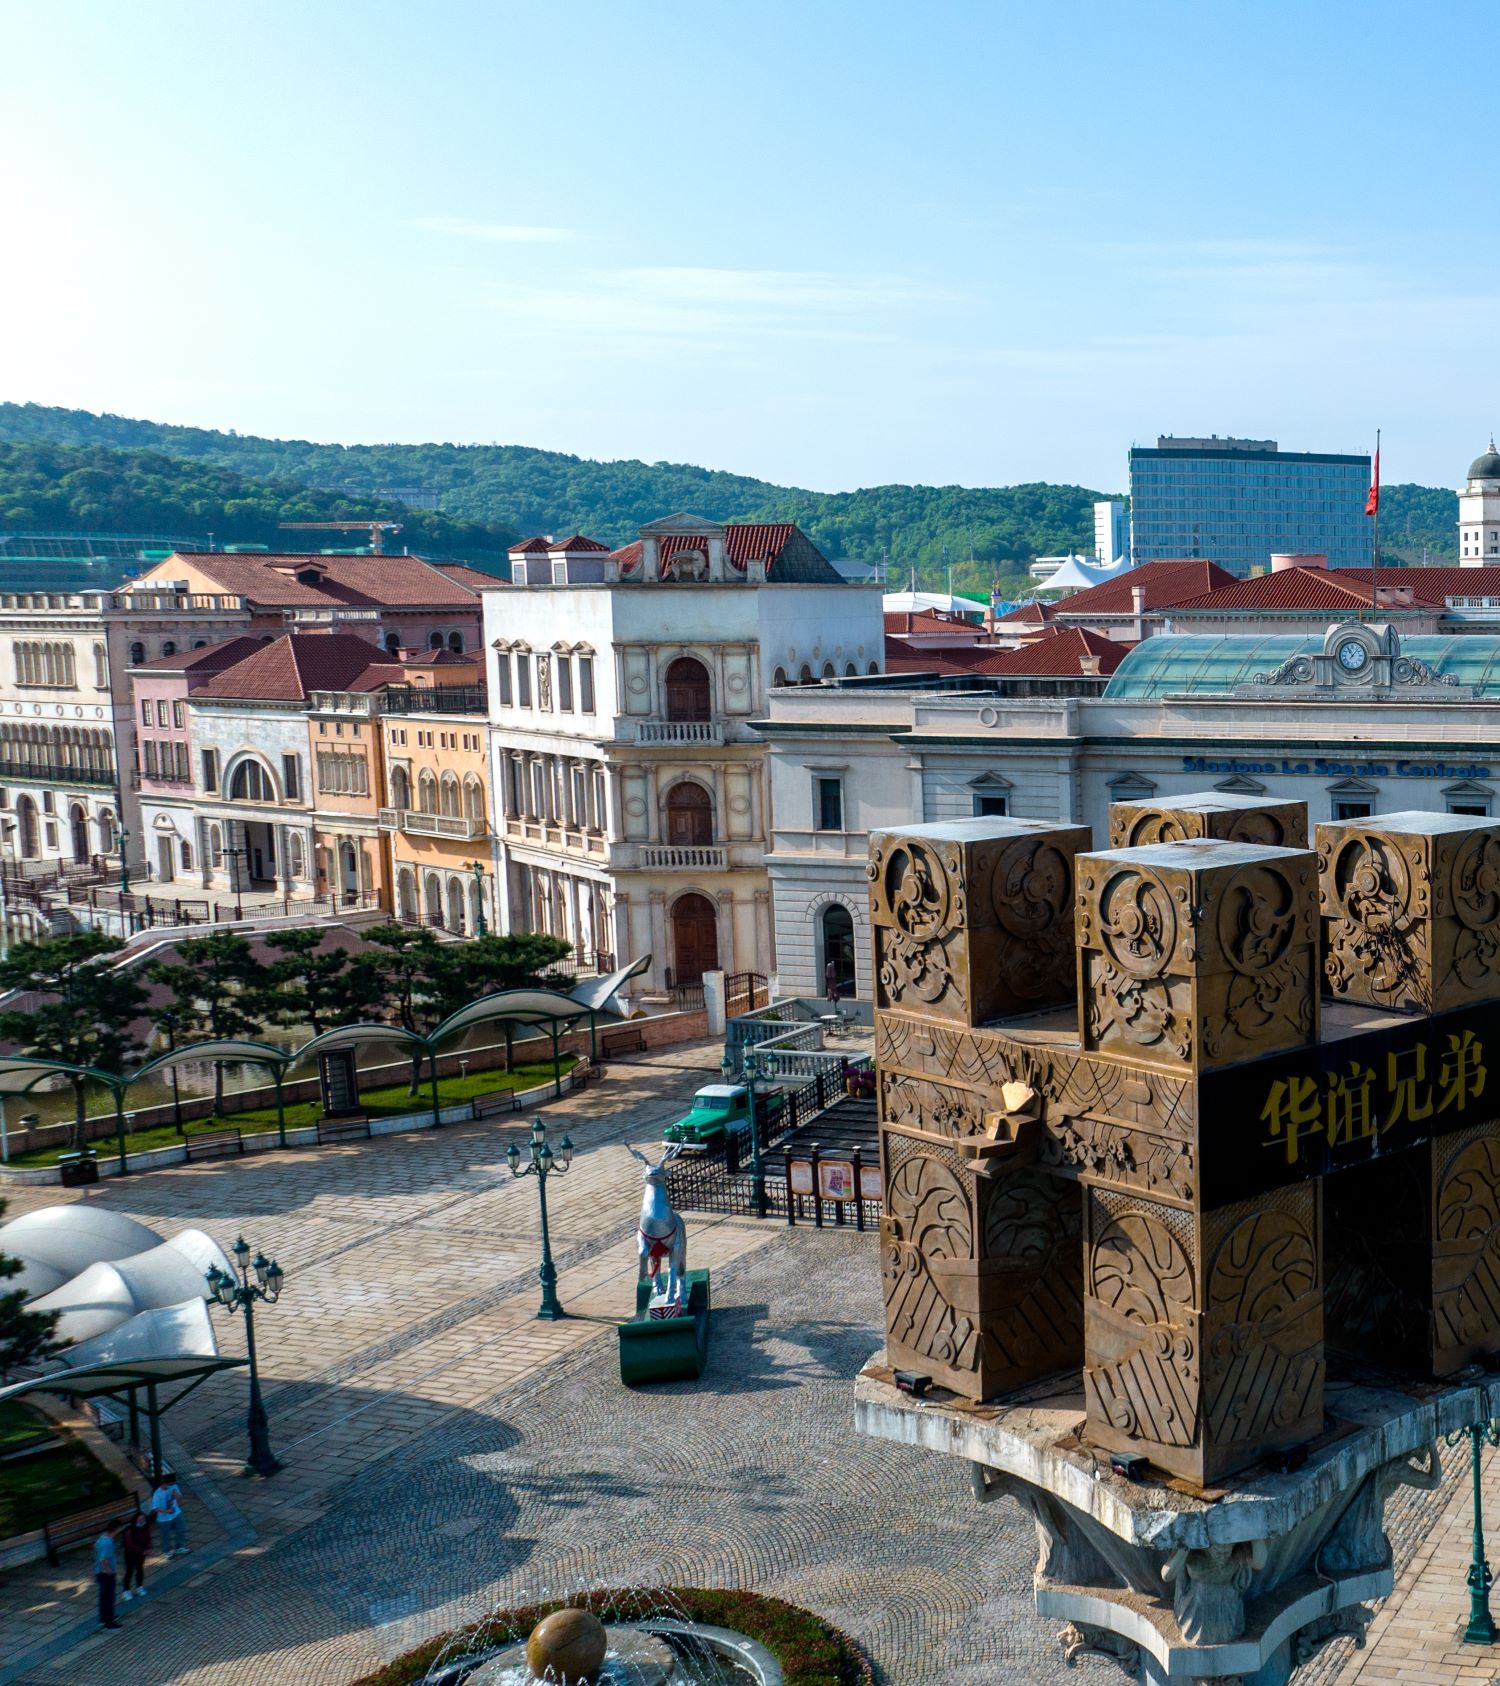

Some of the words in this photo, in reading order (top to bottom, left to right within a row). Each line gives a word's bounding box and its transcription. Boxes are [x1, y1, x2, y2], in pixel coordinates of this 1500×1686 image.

[1183, 756, 1275, 772] Stazione
[1282, 760, 1308, 774] La
[1314, 759, 1388, 776] Spezia
[1396, 759, 1490, 777] Centrale
[1259, 1030, 1487, 1164] 华谊兄弟
